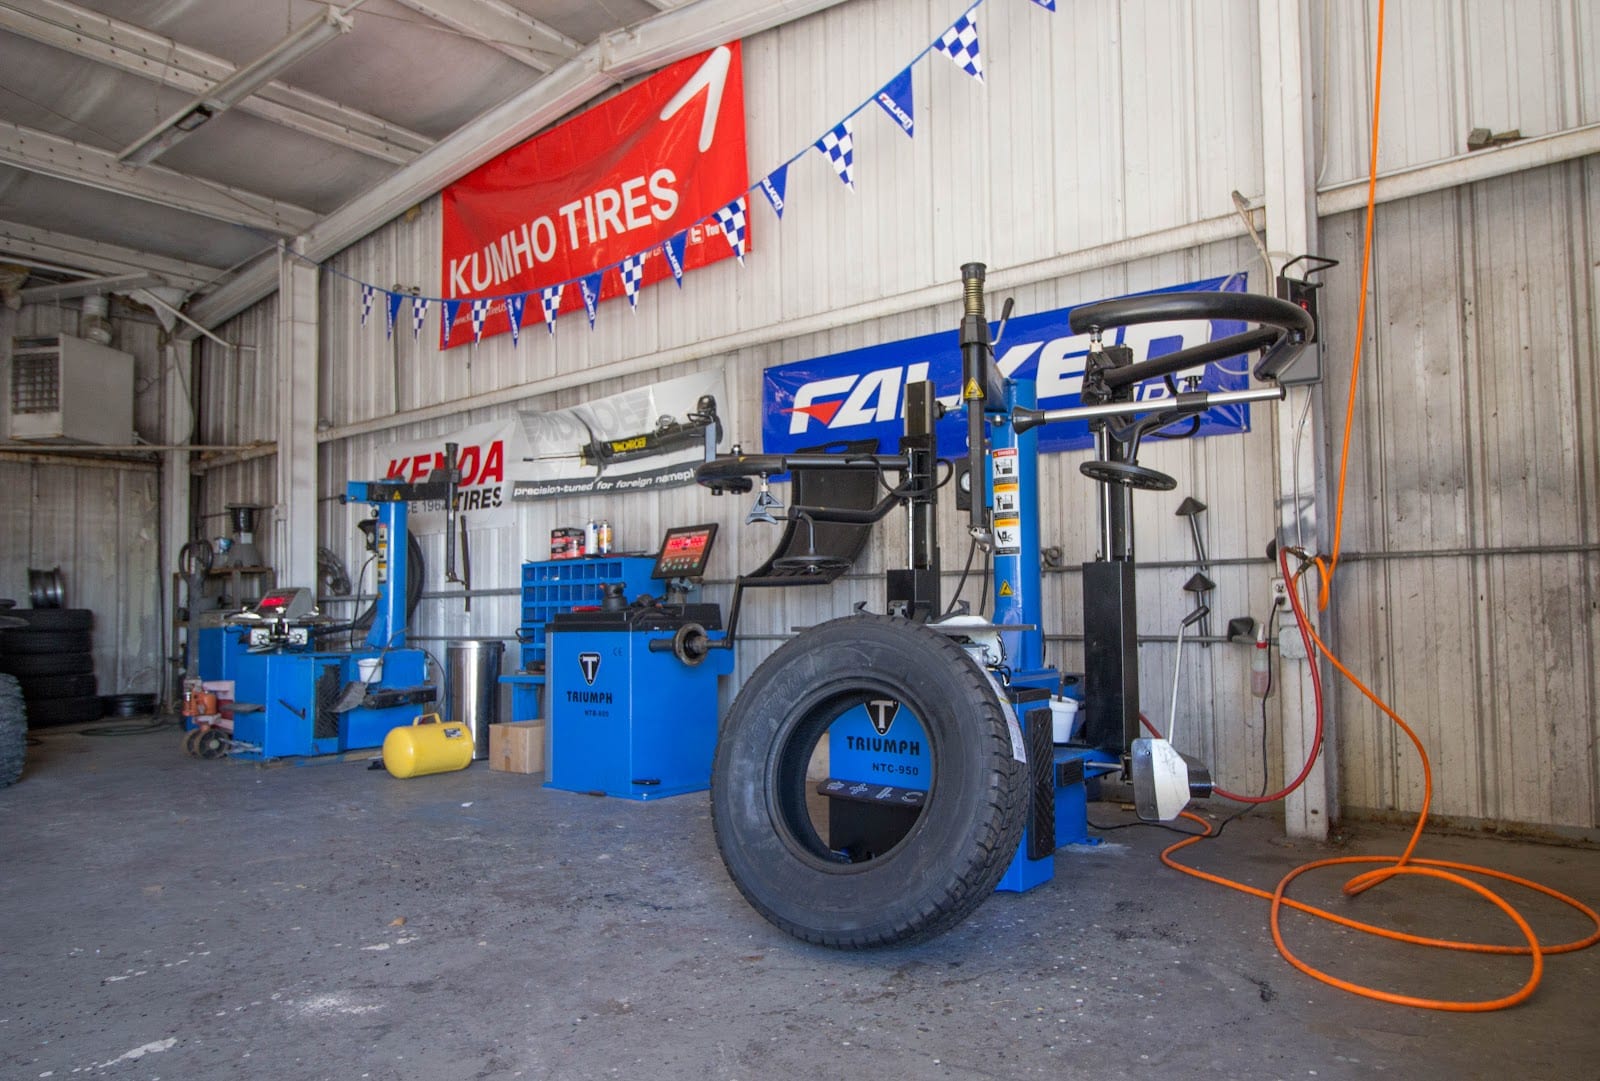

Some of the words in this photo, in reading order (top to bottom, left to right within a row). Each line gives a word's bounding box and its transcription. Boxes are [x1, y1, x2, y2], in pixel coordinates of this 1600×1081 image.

[450, 214, 557, 299] KUMHO
[558, 167, 679, 251] TIRES
[386, 440, 503, 487] KEDA
[514, 482, 594, 497] precision-tuned
[598, 480, 613, 491] for
[615, 477, 653, 490] foreign
[655, 469, 697, 486] namepl
[567, 690, 613, 706] TRIUMPH
[846, 735, 920, 756] TRIUMPH
[872, 762, 919, 777] NTC-950
